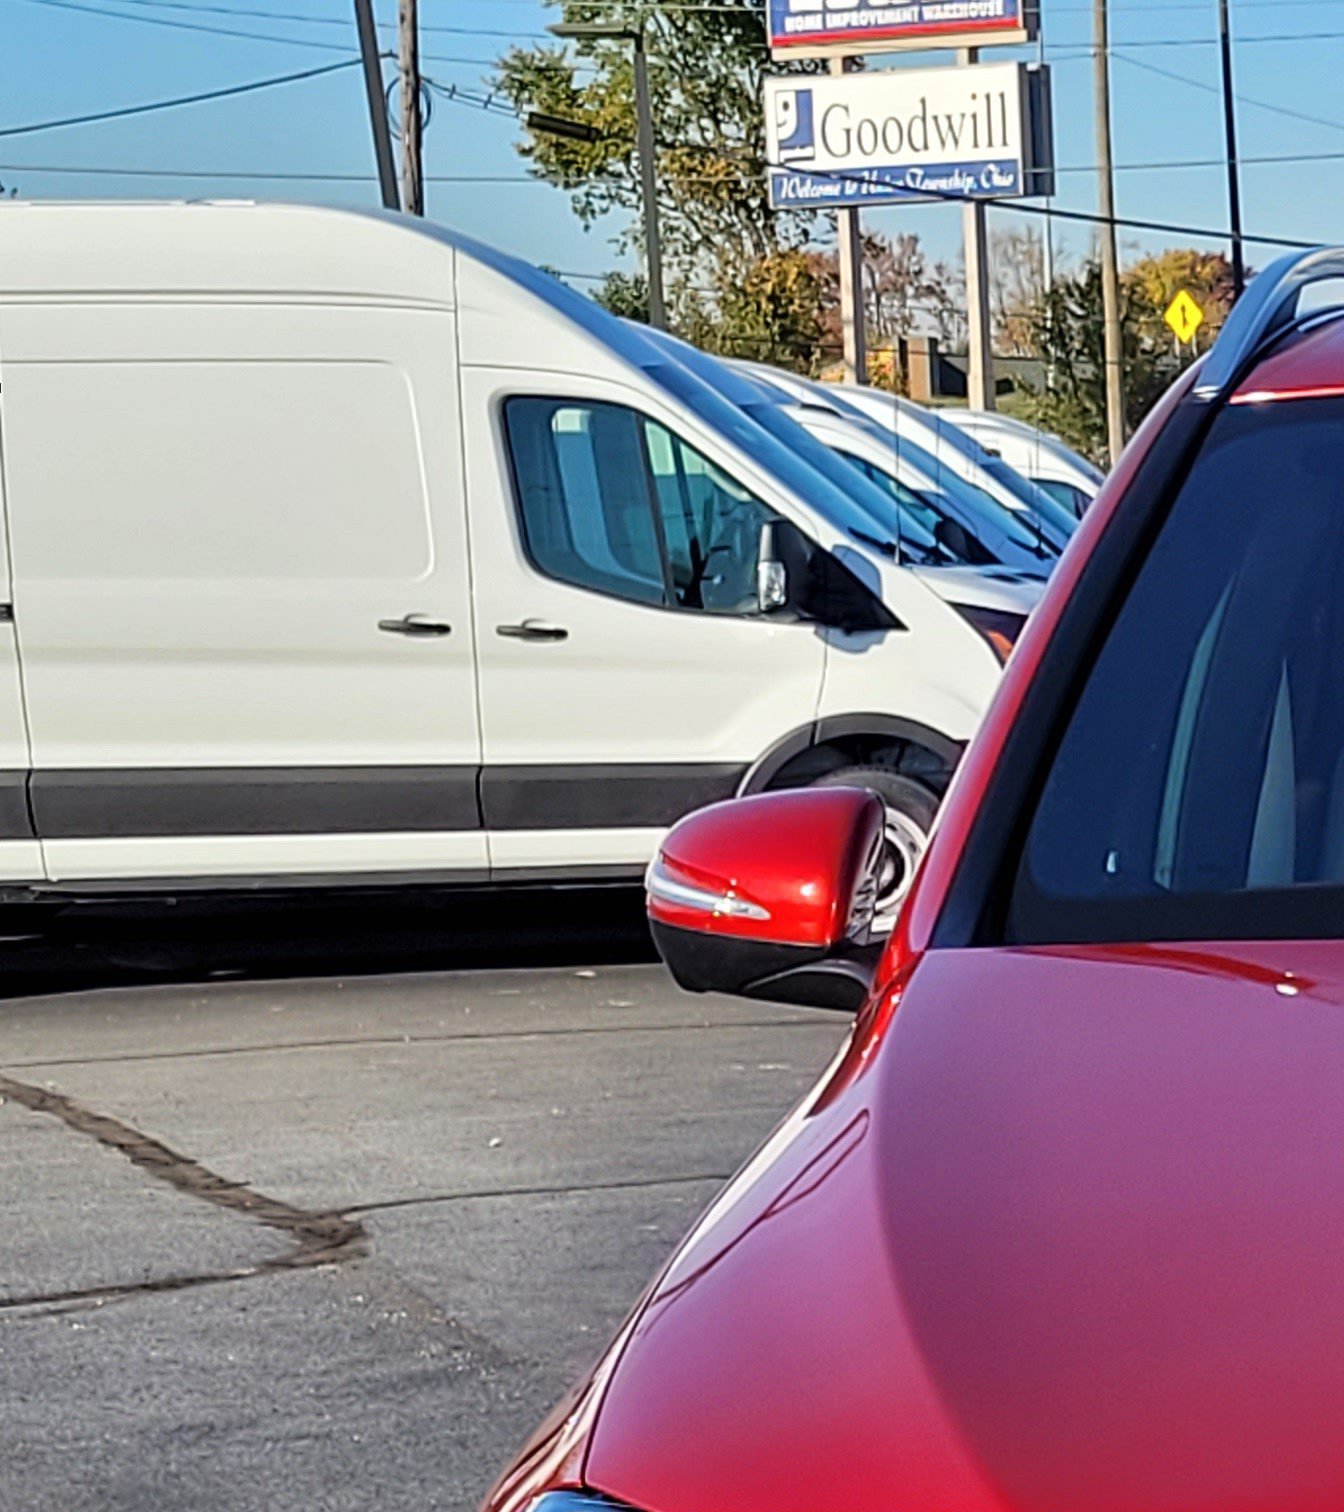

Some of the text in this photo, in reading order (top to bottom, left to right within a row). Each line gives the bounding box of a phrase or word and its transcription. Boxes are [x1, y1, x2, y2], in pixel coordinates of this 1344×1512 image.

[785, 14, 823, 33] HOME
[825, 6, 920, 29] IMPROVEMENT
[922, 0, 1004, 21] WAREHOUSE
[821, 91, 1010, 158] Goodwill
[780, 176, 842, 199] Welcome
[980, 163, 1015, 190] Ohio
